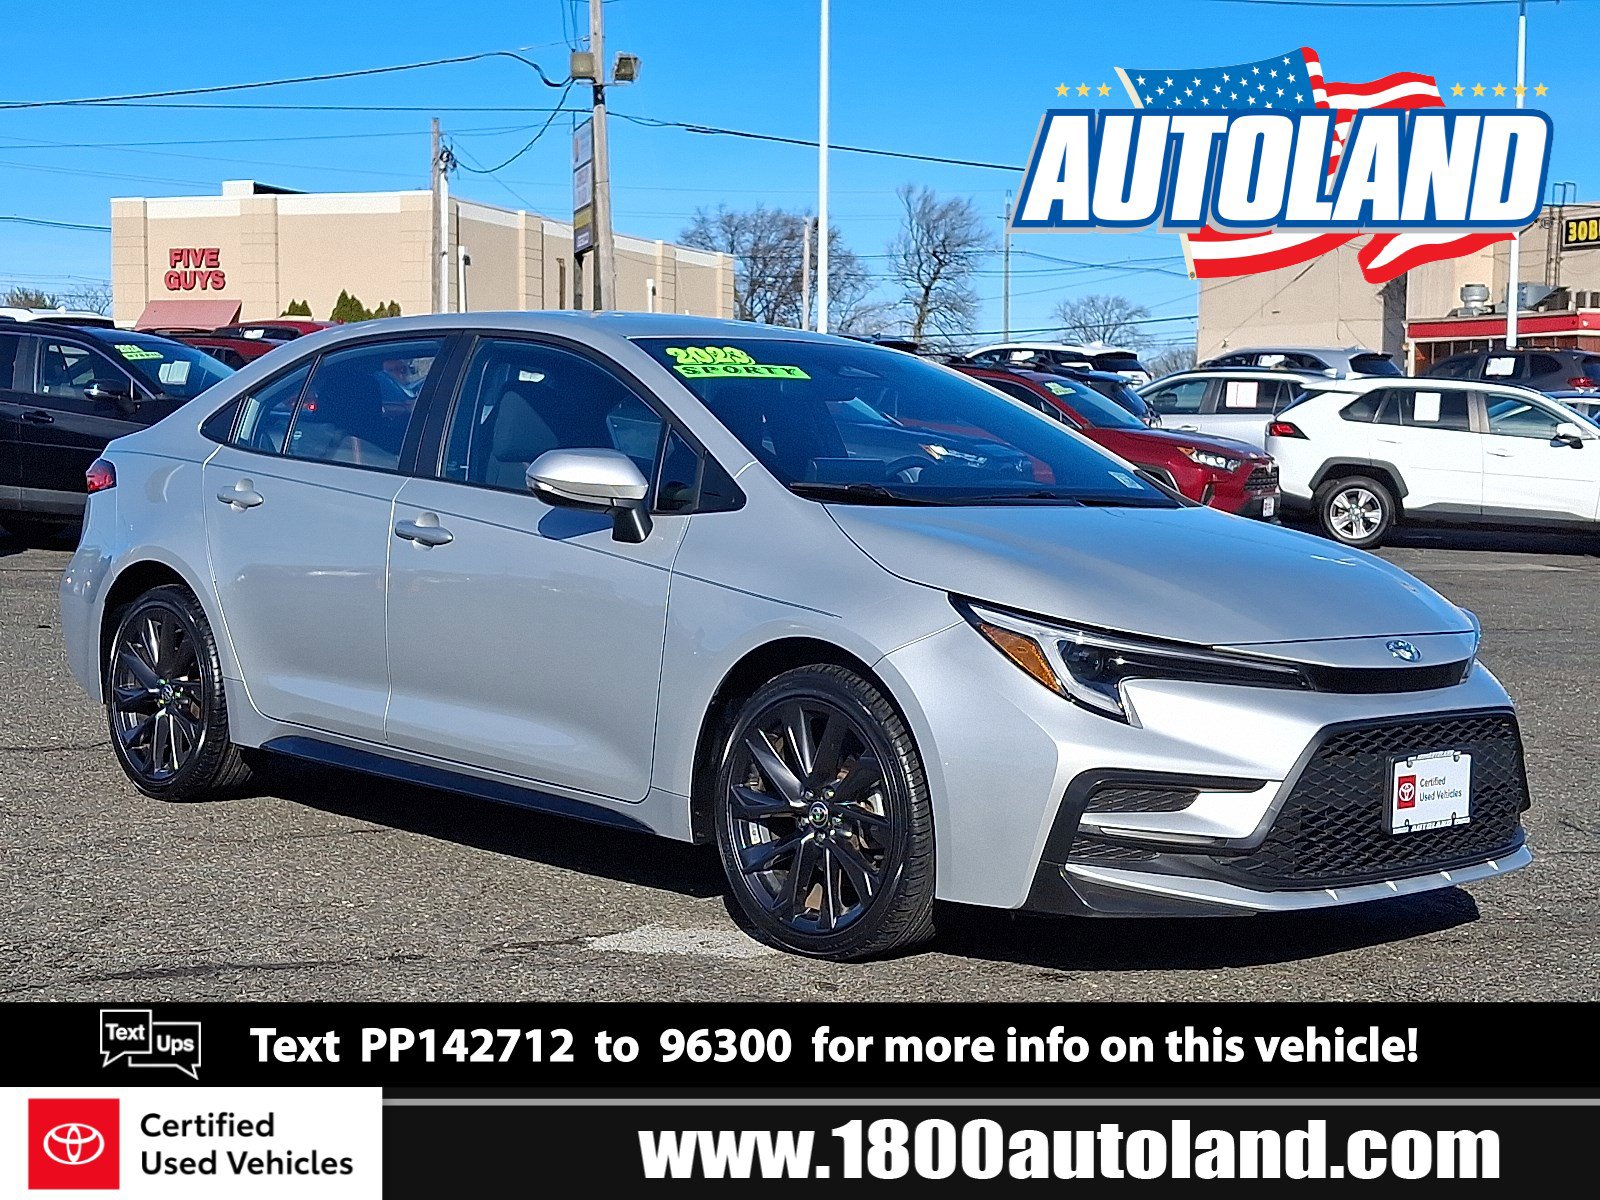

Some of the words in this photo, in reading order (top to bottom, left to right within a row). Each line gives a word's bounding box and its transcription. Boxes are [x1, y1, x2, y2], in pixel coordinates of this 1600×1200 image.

[169, 248, 220, 269] FIVE
[164, 270, 226, 291] GUYS
[680, 364, 798, 377] SPORTY
[1420, 776, 1447, 788] Certified
[1419, 791, 1435, 802] Used
[1437, 788, 1462, 800] Vehicles
